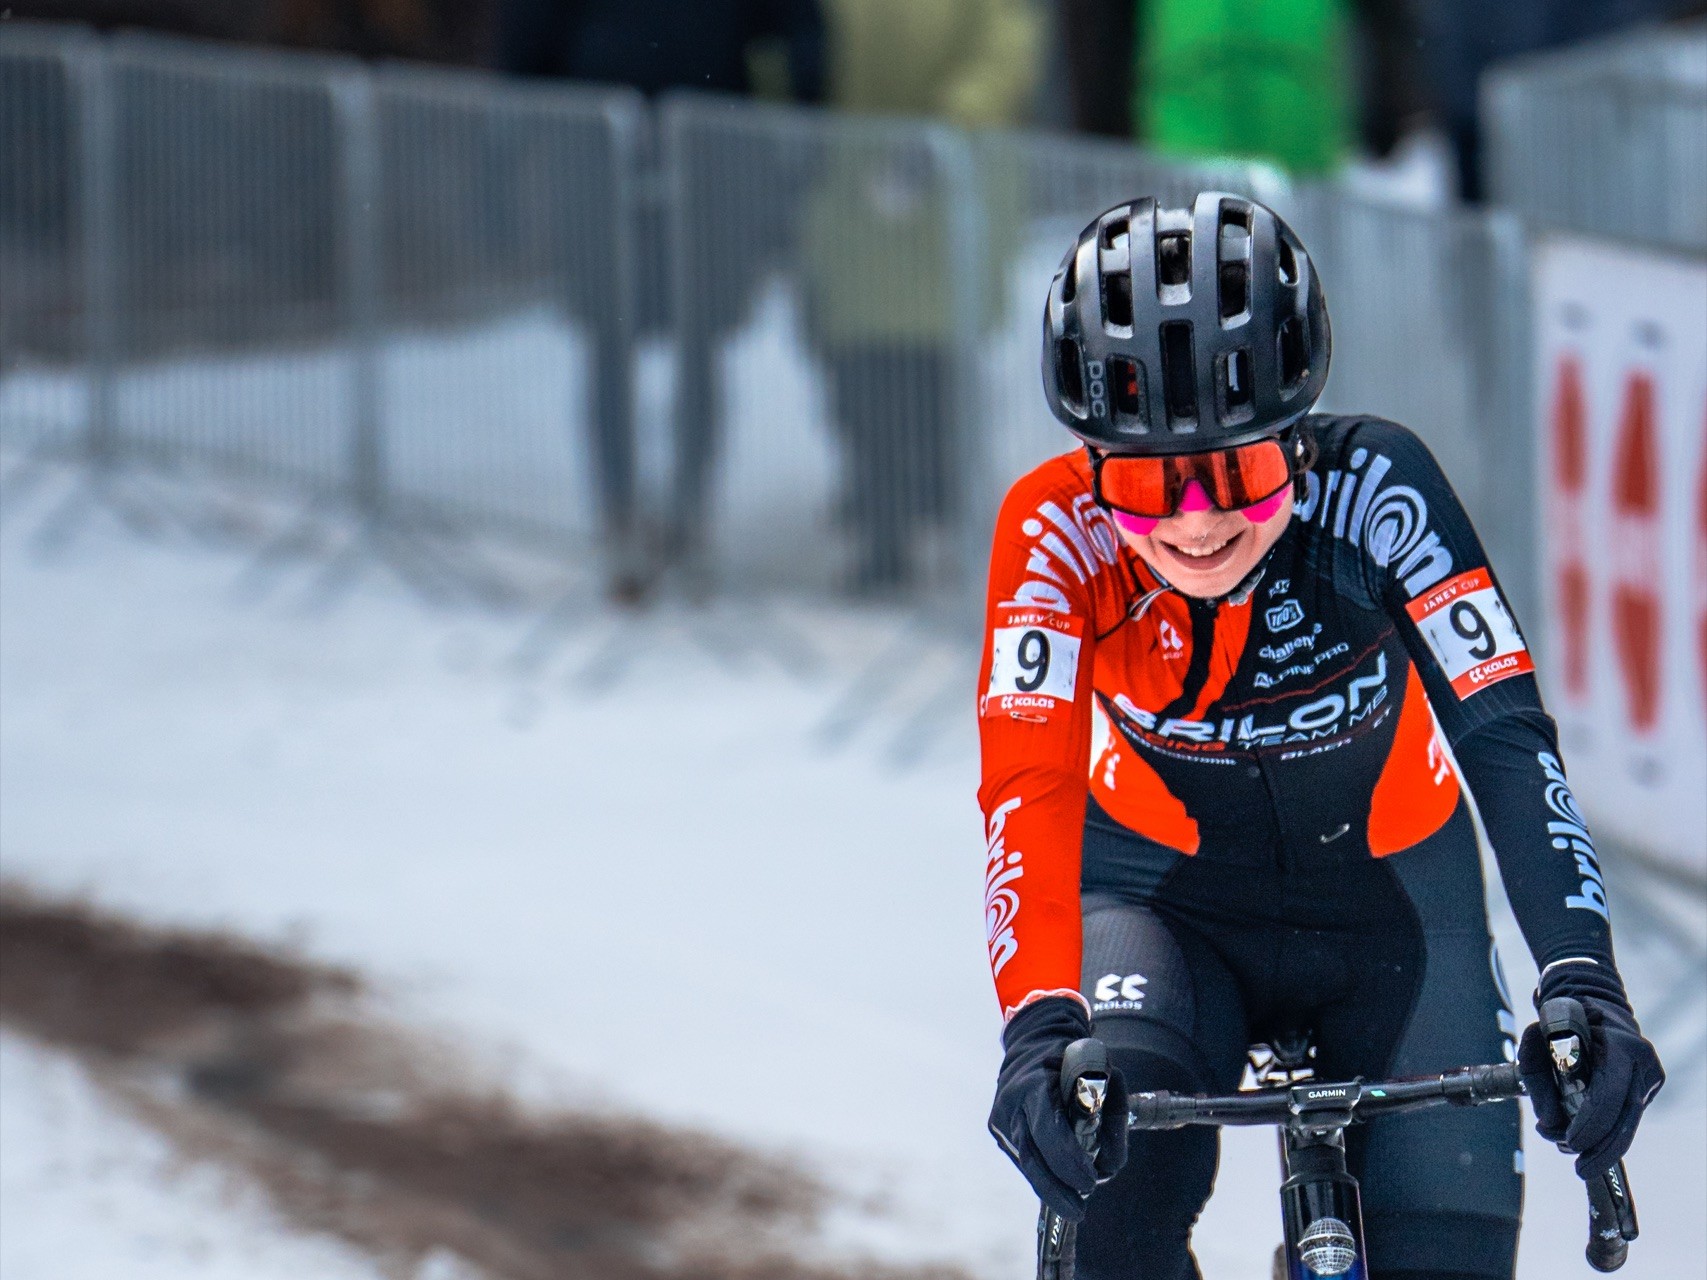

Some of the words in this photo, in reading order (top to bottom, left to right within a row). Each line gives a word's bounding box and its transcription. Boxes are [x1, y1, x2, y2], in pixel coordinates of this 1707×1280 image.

[998, 491, 1127, 614] brilo
[1008, 613, 1045, 625] JANEV
[1048, 617, 1071, 630] CUP
[1423, 586, 1458, 613] JANEV
[1460, 578, 1481, 591] CUP
[1014, 629, 1051, 692] 9
[1449, 600, 1497, 661] 9
[1113, 651, 1387, 743] BRILON
[1308, 1088, 1346, 1099] GARMIN
